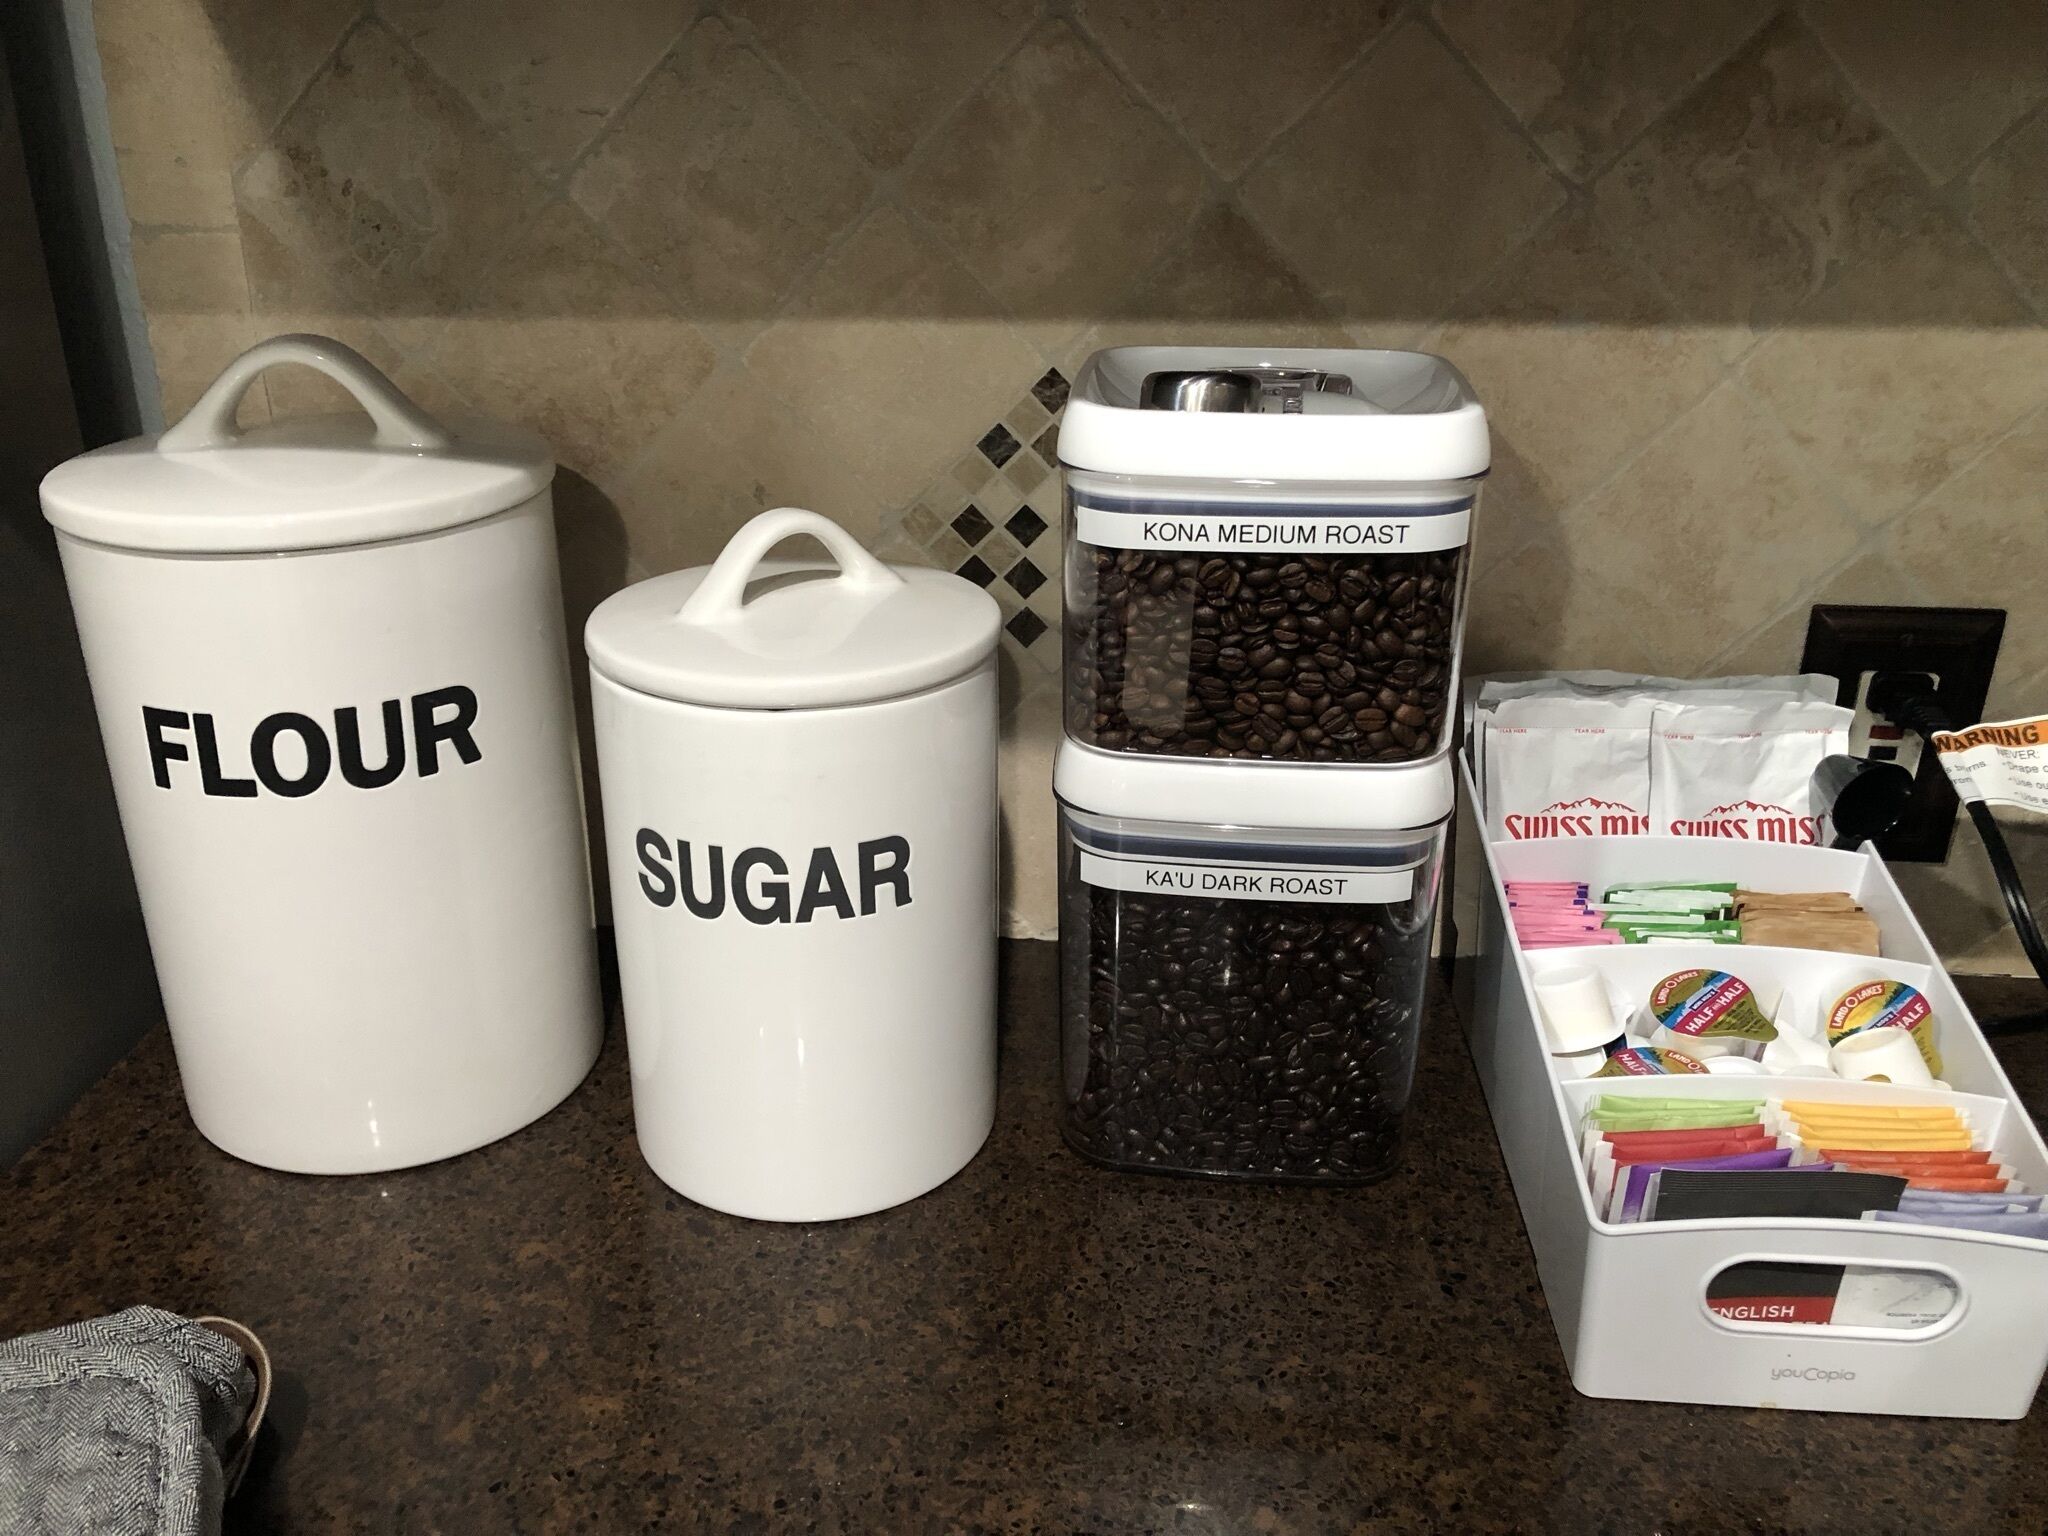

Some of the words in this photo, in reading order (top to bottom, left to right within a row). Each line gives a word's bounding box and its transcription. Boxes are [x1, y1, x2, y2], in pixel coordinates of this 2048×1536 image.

[1143, 522, 1210, 543] KONA
[1218, 524, 1316, 545] MEDIUM
[1325, 524, 1410, 545] ROAST
[142, 685, 482, 799] FLOUR
[1936, 725, 2040, 752] WARNING
[635, 828, 913, 925] SUGAR
[1145, 870, 1194, 889] KA'U
[1202, 874, 1263, 893] DARK
[1270, 877, 1348, 896] ROAST
[1675, 971, 1699, 983] LAKES
[1685, 1007, 1716, 1033] HALF
[1717, 982, 1745, 1006] HALF
[1832, 1006, 1849, 1027] LAND
[1856, 984, 1883, 1001] LAKES
[1891, 1002, 1925, 1030] HALF
[1619, 1053, 1645, 1073] HALF
[1668, 1052, 1690, 1065] LAND
[1771, 1367, 1856, 1383] youCopia
